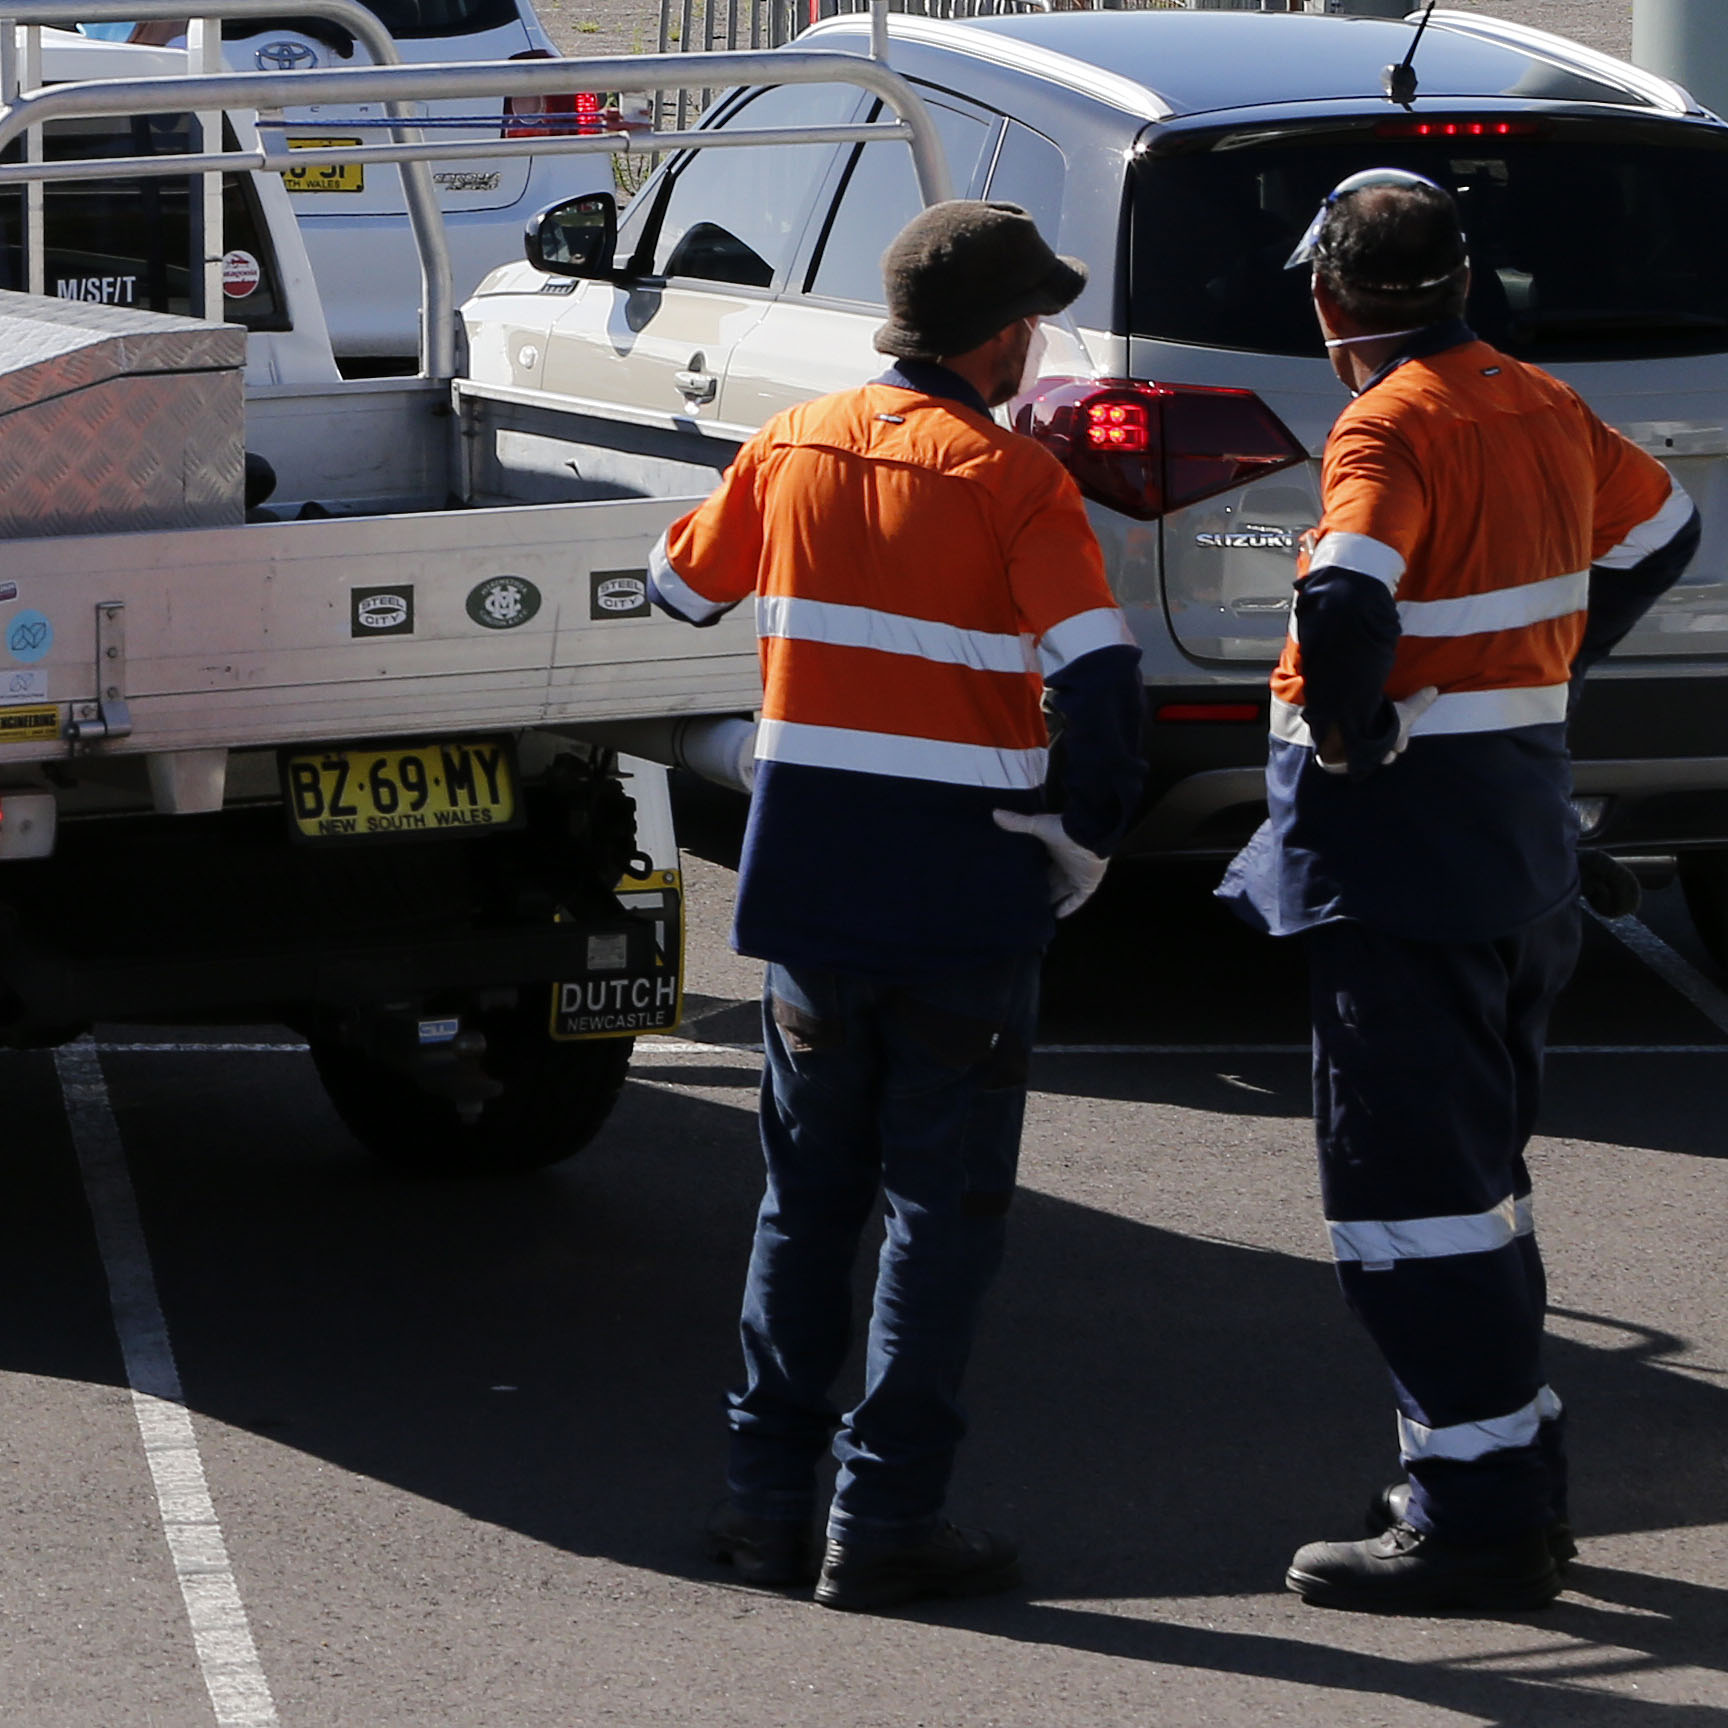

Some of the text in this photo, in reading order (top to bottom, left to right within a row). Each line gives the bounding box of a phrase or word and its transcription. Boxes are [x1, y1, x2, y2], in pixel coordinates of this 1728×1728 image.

[307, 180, 341, 188] WALES
[57, 276, 136, 304] M/SF/T
[1196, 533, 1293, 548] SUZUKI
[601, 578, 642, 592] STEEL
[361, 595, 404, 610] STEEL
[604, 597, 638, 609] CITY
[364, 614, 401, 627] CITY
[319, 808, 493, 833] NEW SOUTH WALES
[561, 976, 675, 1013] DUTCH
[568, 1010, 665, 1032] NEWCASTLE
